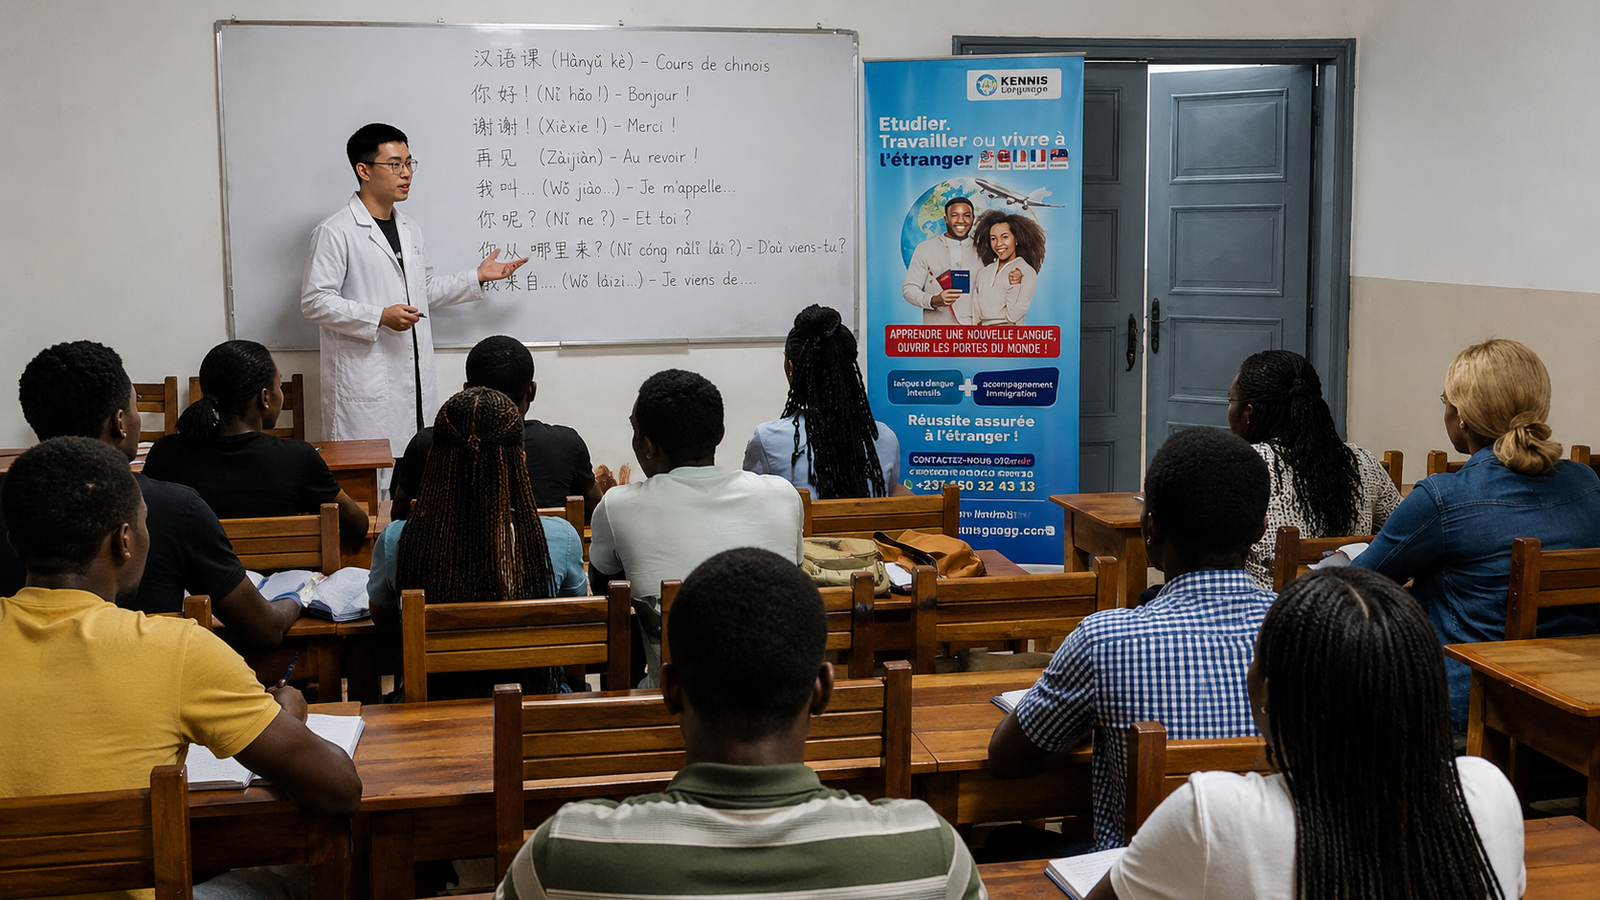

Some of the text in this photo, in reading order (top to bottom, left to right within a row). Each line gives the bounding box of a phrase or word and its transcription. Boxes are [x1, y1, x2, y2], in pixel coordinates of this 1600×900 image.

[473, 48, 542, 69] 汉语课
[611, 51, 634, 71] kè)
[655, 53, 694, 71] Cours
[701, 55, 717, 71] de
[724, 55, 771, 73] chinois
[1001, 76, 1048, 86] KENNIS
[628, 86, 678, 108] Bonjour
[627, 118, 663, 133] Merci
[879, 116, 951, 132] Etudier.
[879, 131, 1066, 149] Travailler ou vivre à
[476, 148, 517, 168] 再见
[623, 149, 640, 164] Au
[648, 151, 686, 164] revoir
[880, 151, 973, 169] l'étranger
[639, 179, 655, 195] Je
[578, 217, 594, 226] ne
[636, 210, 652, 226] Et
[659, 210, 677, 225] toi
[662, 271, 677, 287] Je
[684, 274, 715, 286] viens
[890, 329, 1057, 342] APPRENDRE UNE NOUVELLE LANGUE,
[897, 342, 930, 353] OUVRIR
[933, 342, 950, 353] LES
[953, 343, 987, 353] PORTES
[991, 343, 1004, 353] DU
[1007, 343, 1041, 354] MONDE
[908, 414, 1035, 427] Réussite assurée
[924, 430, 934, 442] à
[937, 429, 1011, 444] l'étranger
[977, 480, 994, 491] 32
[998, 481, 1015, 491] 43
[1019, 481, 1035, 492] 13
